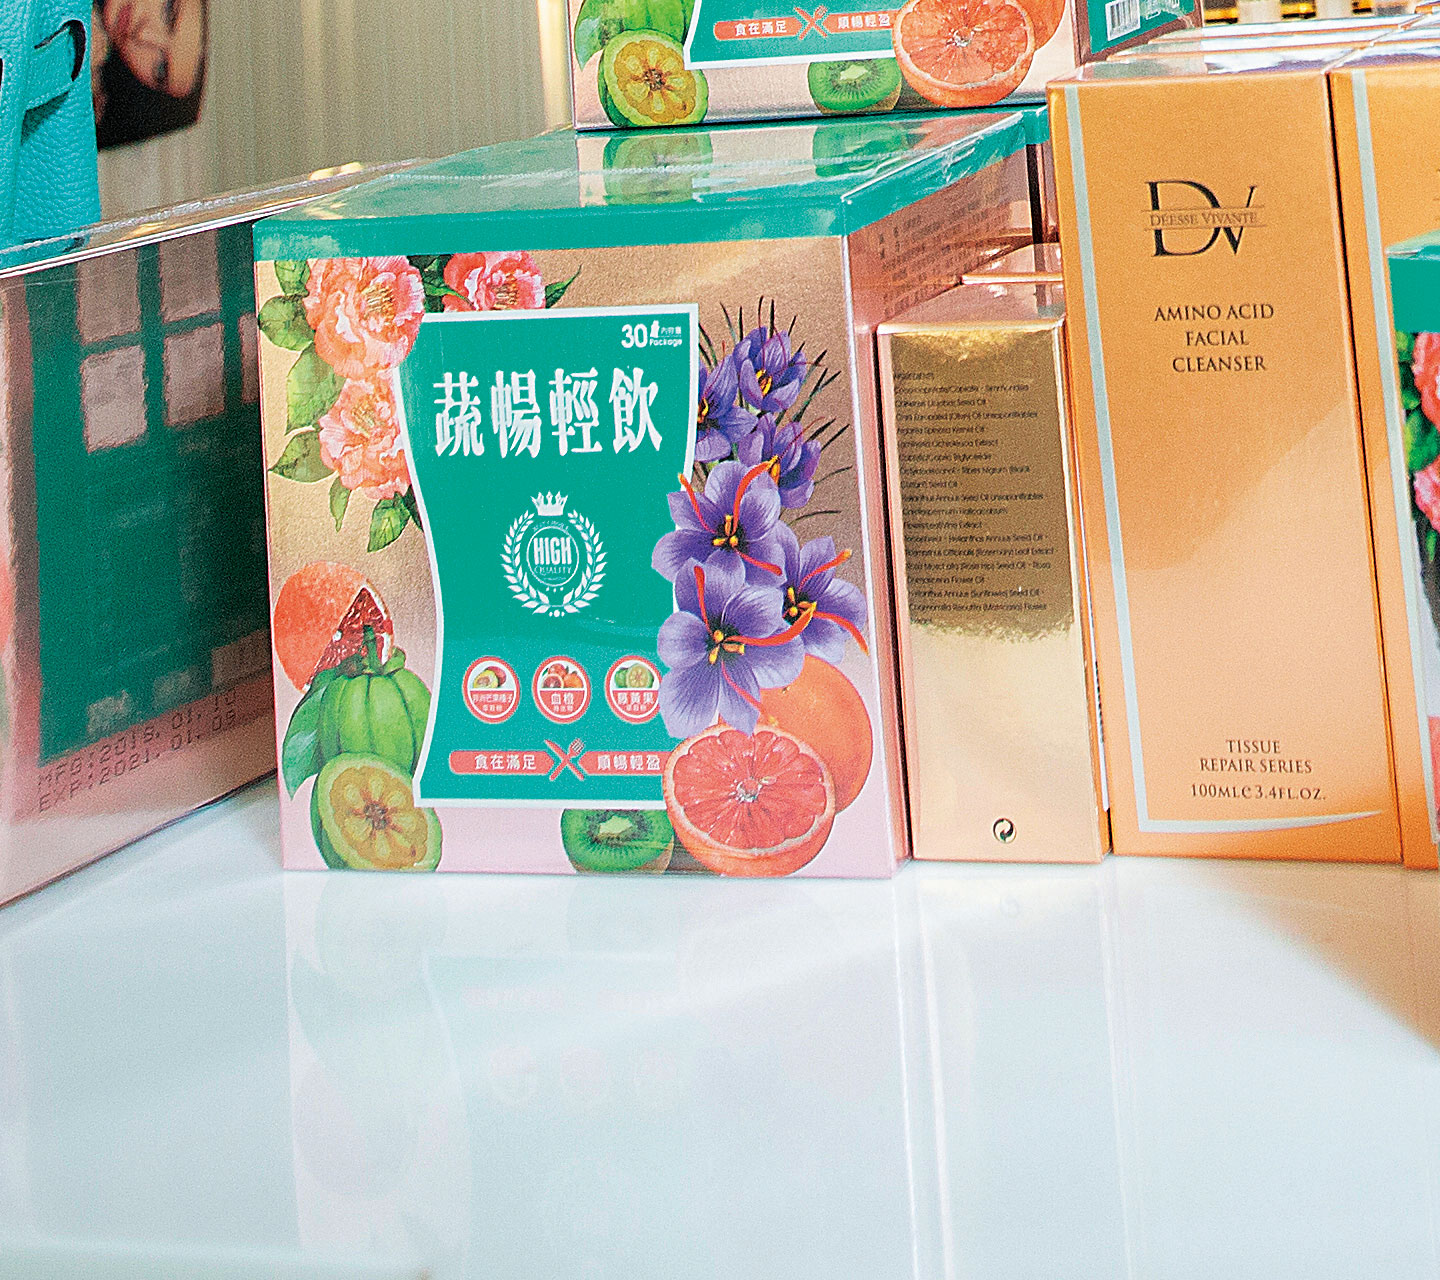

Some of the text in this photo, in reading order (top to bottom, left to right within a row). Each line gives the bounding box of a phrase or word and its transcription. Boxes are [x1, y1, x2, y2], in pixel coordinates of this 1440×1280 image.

[1145, 179, 1258, 257] DV
[1201, 211, 1258, 225] VIVANTE
[1154, 303, 1275, 322] AMINO ACID
[621, 323, 648, 348] 30
[1185, 330, 1250, 347] FACIAL
[1172, 355, 1266, 373] CLEANSER
[433, 366, 663, 458] 蔬暢輕飲
[533, 537, 572, 565] HIGH
[1225, 739, 1281, 754] TISSUE
[474, 754, 661, 771] 食在滿足 順暢輕盈
[1200, 757, 1312, 774] REPAIR SERIES
